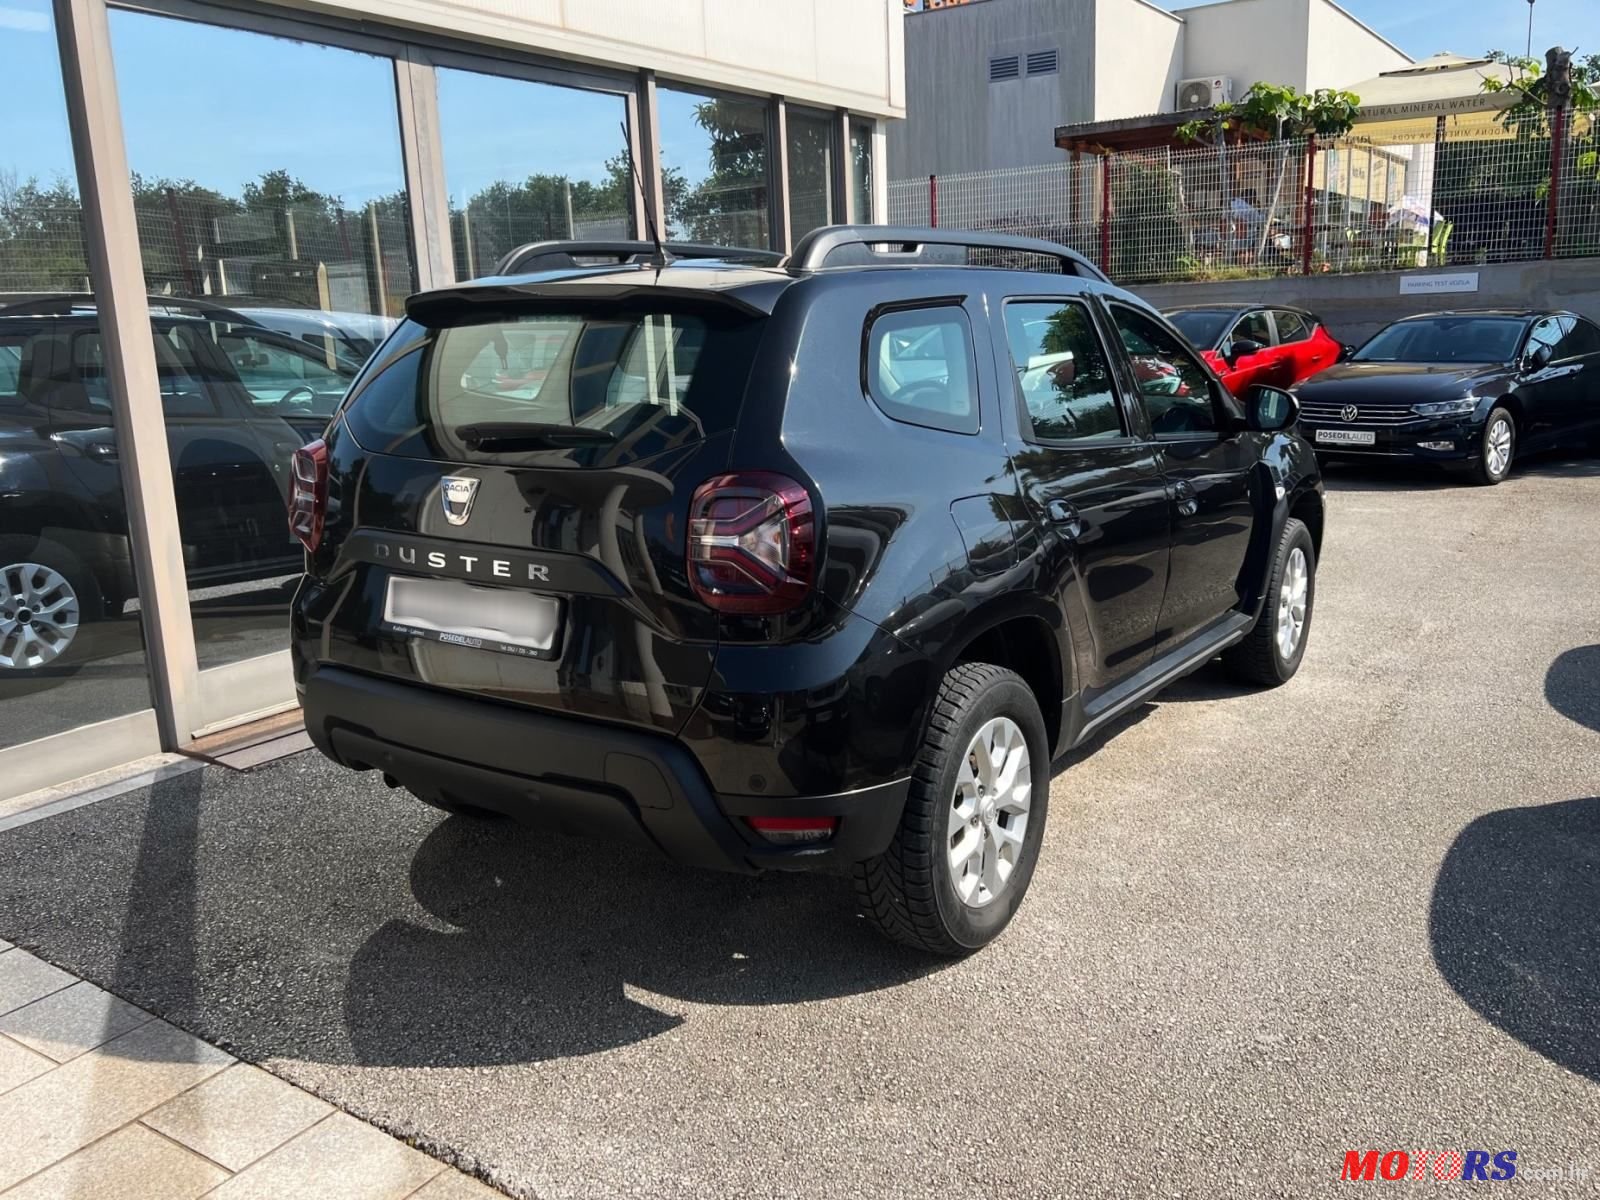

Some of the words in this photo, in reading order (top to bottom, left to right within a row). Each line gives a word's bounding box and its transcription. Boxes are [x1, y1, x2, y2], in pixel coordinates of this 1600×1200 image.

[1360, 107, 1399, 118] ATURAL
[1400, 103, 1447, 113] MINERAL
[1449, 98, 1486, 109] WATER
[444, 484, 469, 493] DACIA
[374, 542, 550, 582] DUSTER
